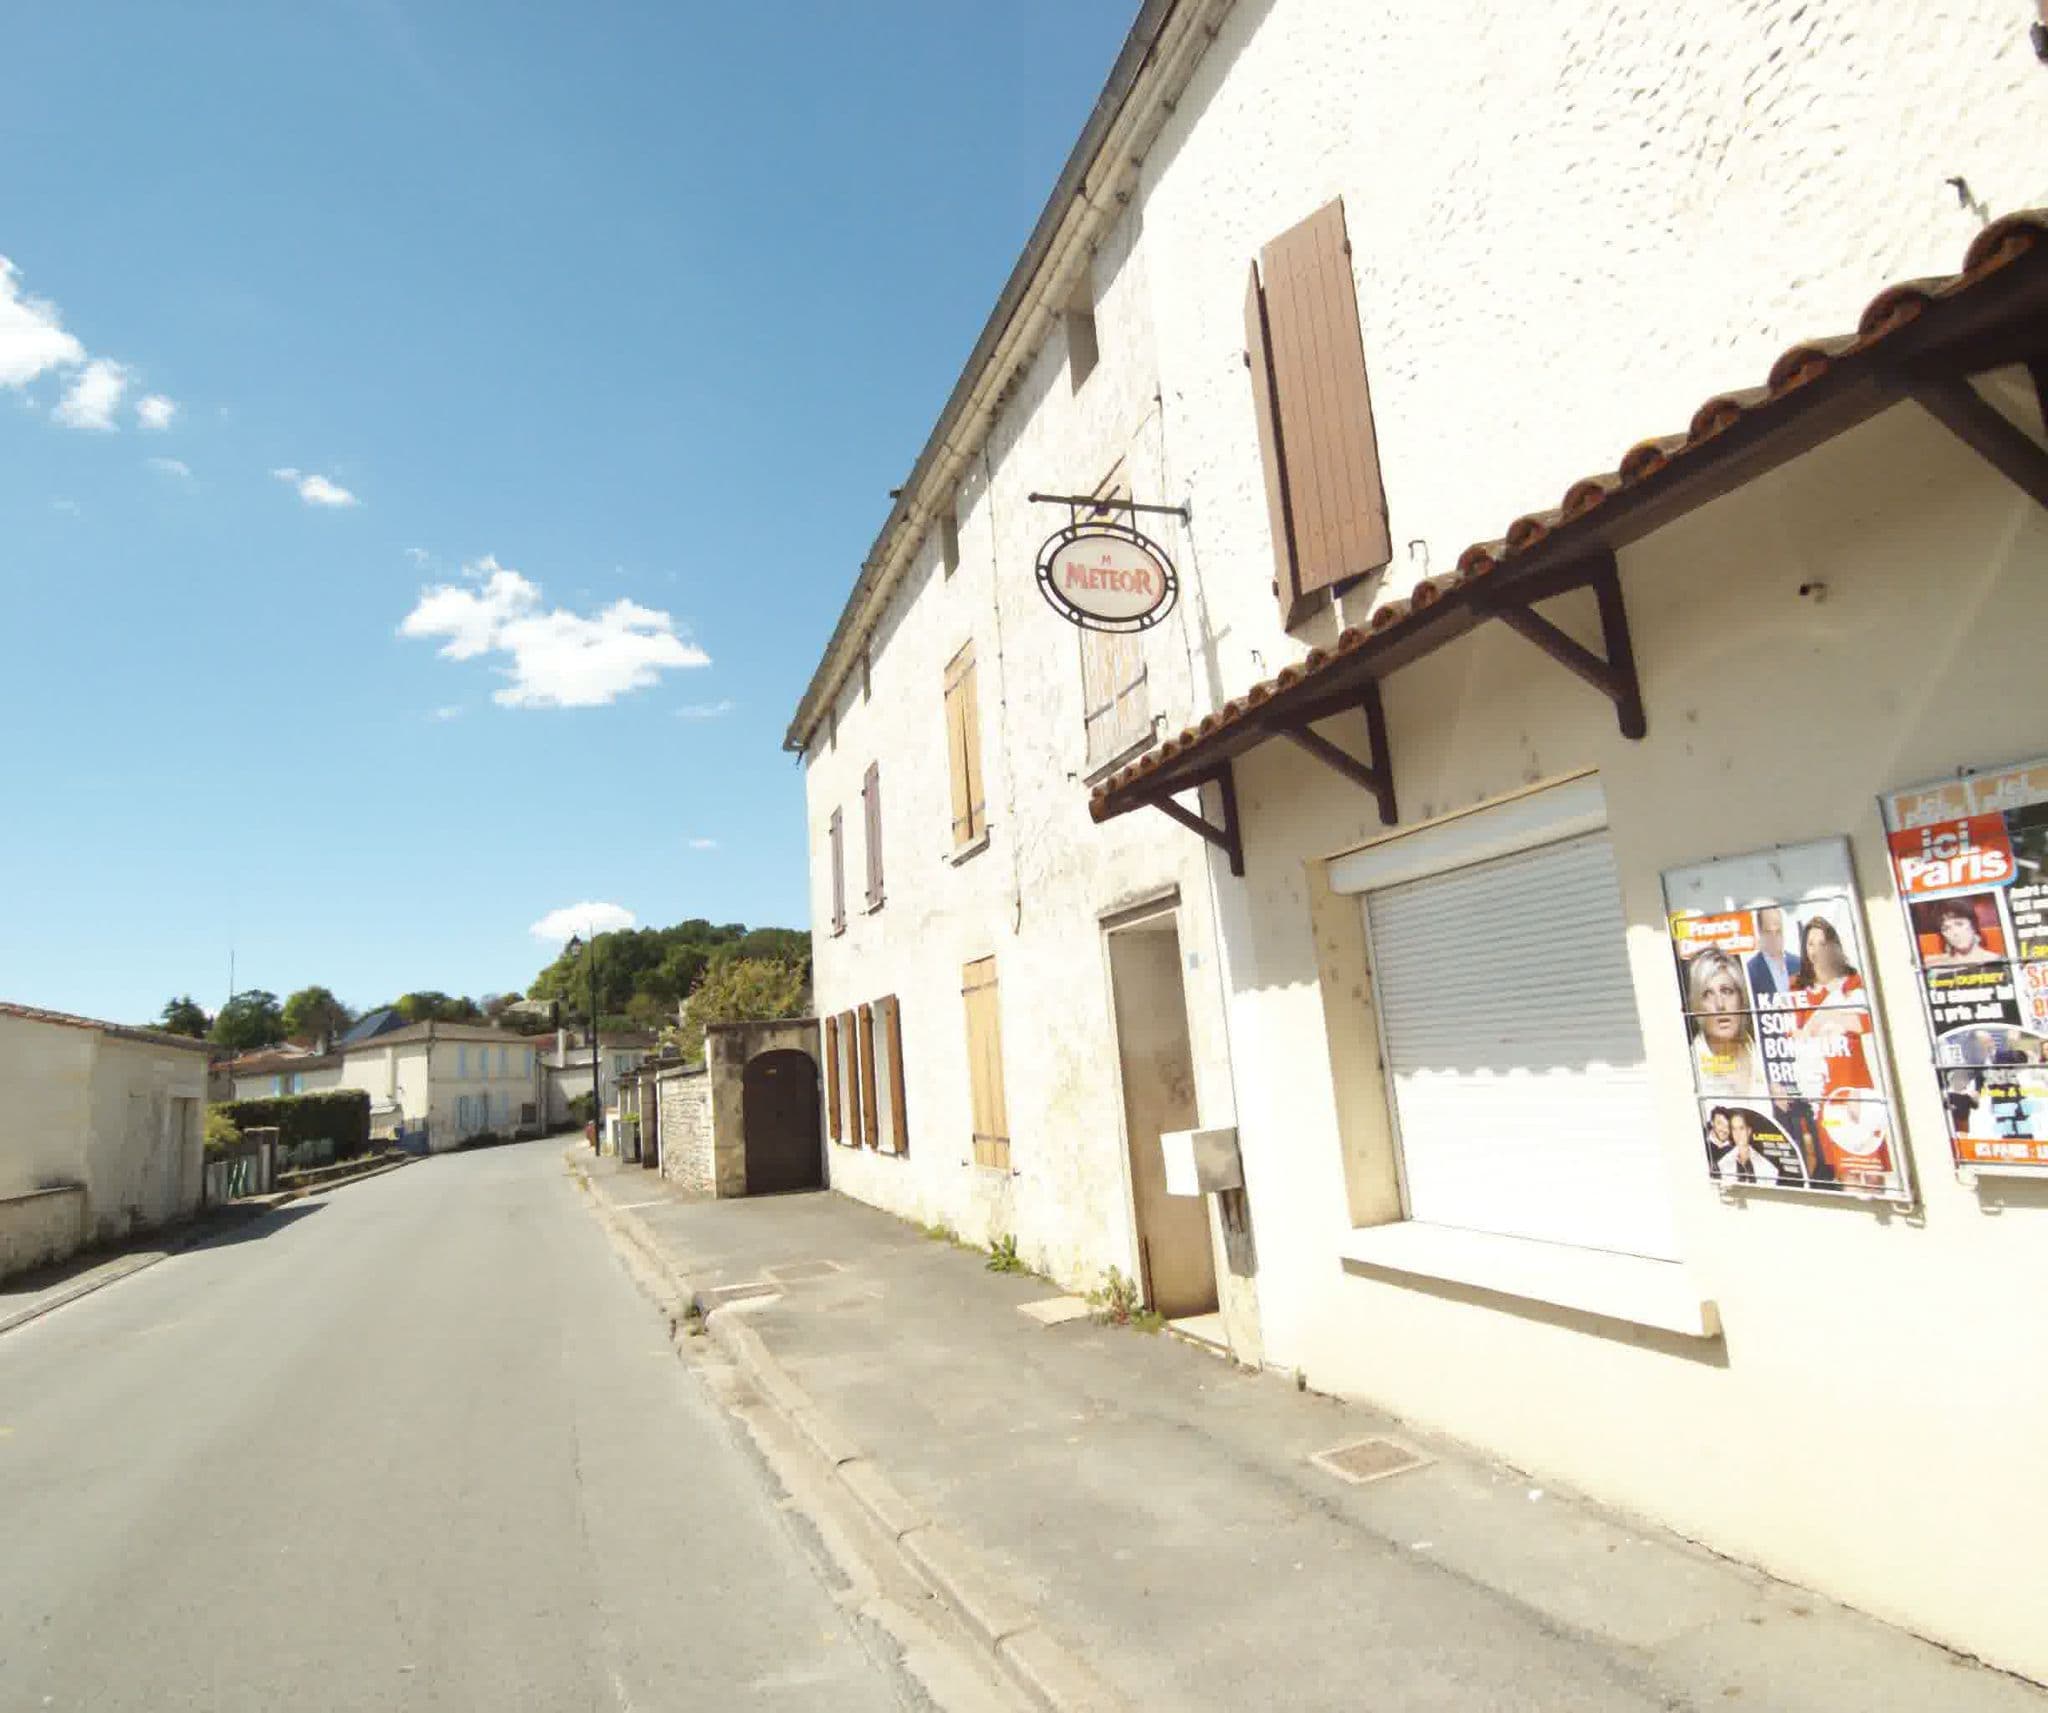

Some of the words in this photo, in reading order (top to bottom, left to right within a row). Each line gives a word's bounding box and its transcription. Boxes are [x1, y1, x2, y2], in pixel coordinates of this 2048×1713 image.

[1065, 562, 1152, 595] METEOR
[1921, 821, 1970, 863] ici
[1901, 846, 2009, 892] Paris
[1757, 988, 1808, 1011] KATE
[1761, 1012, 1795, 1034] SON
